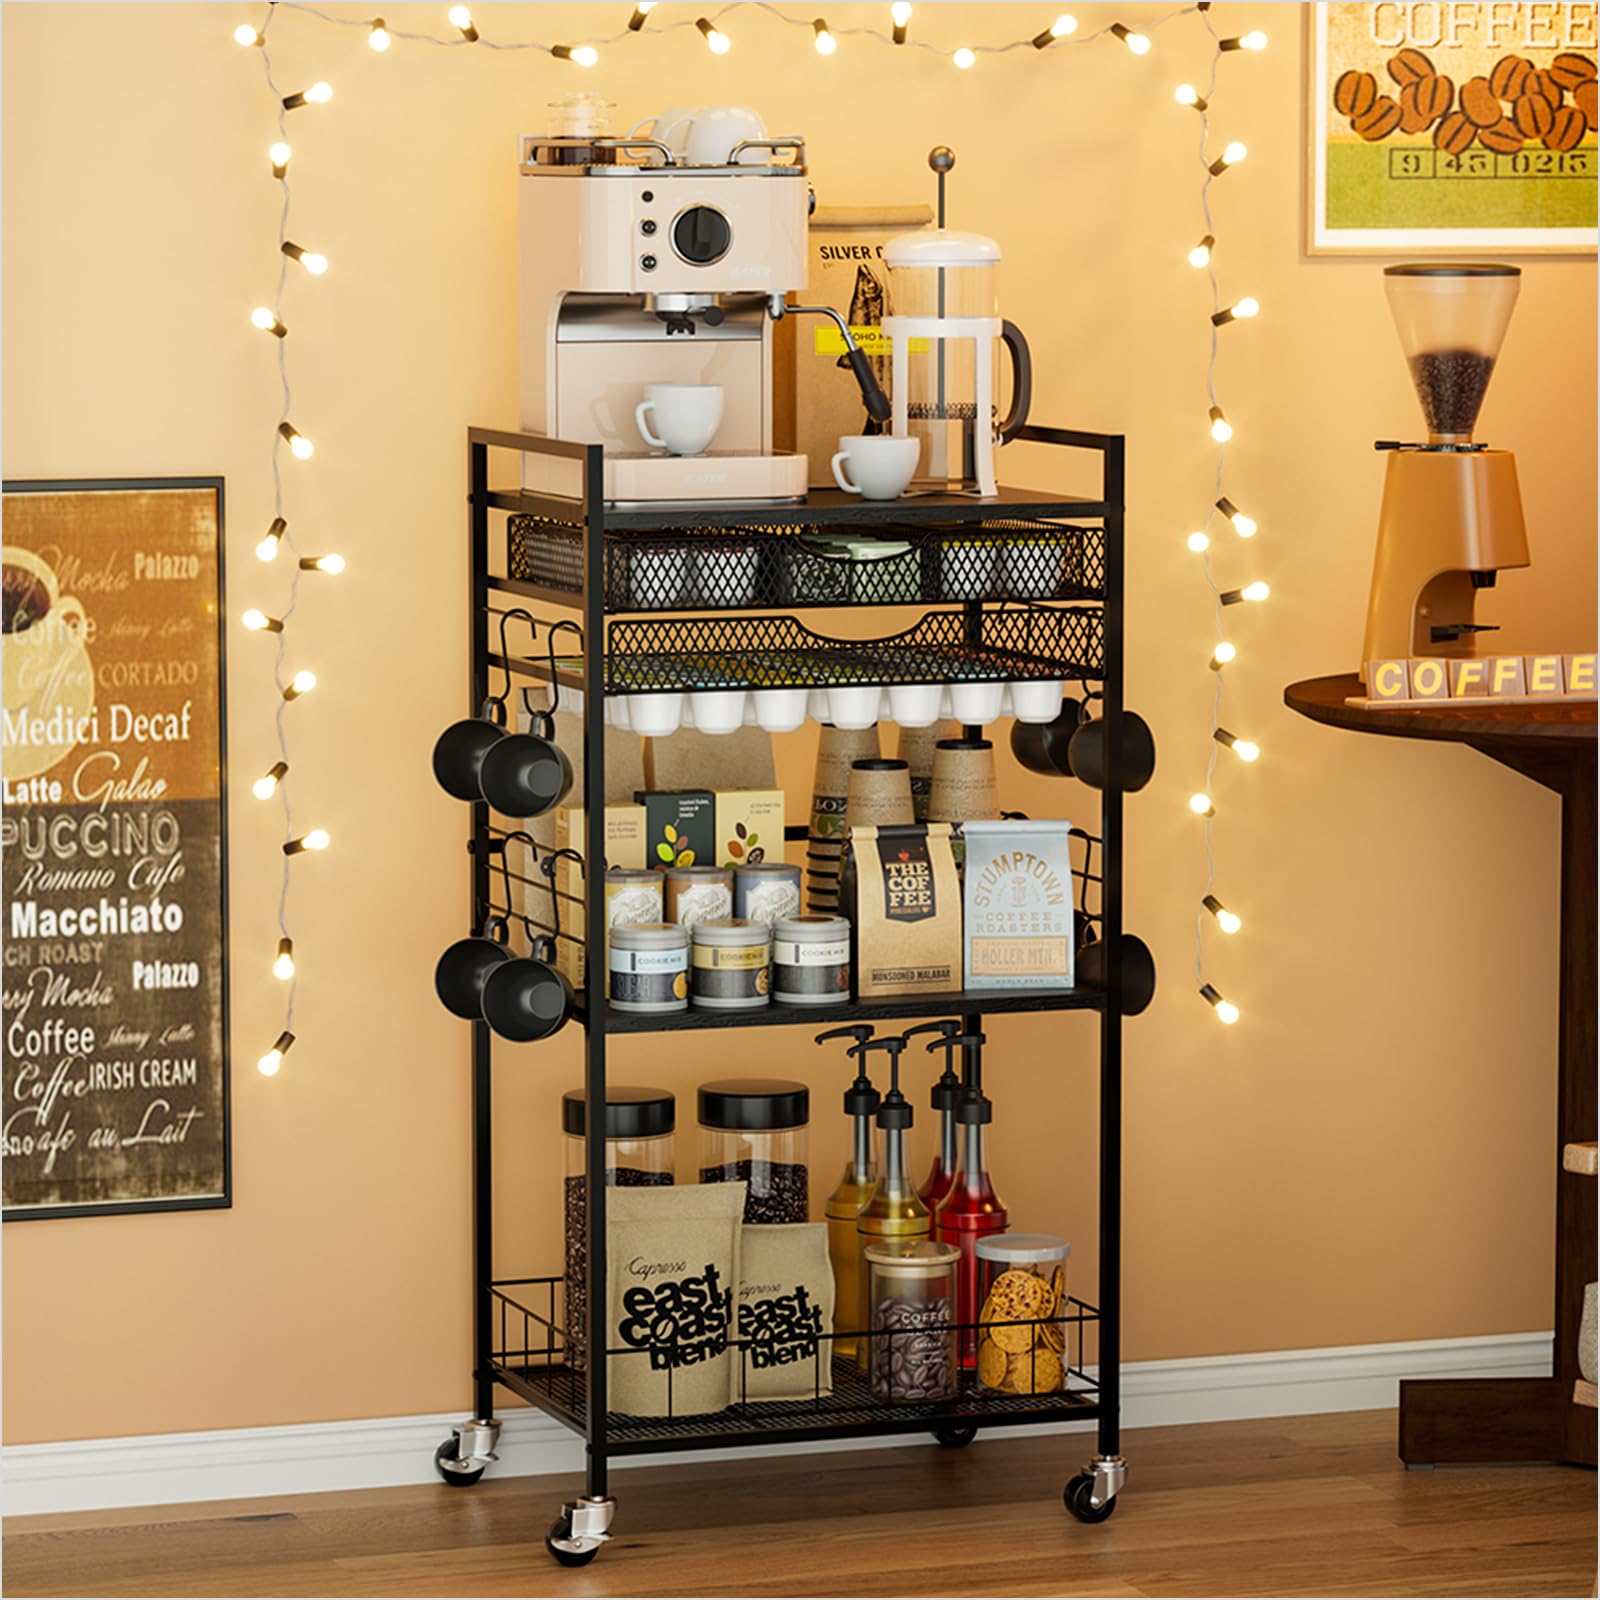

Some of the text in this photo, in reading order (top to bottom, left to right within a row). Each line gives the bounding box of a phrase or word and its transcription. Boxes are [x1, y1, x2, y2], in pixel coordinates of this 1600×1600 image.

[1370, 2, 1598, 49] COFFEE
[1403, 154, 1421, 173] 9
[820, 245, 872, 260] SILVER
[133, 552, 200, 581] Palazzo
[98, 661, 198, 688] CORTADO
[1375, 656, 1596, 697] COFFEE
[2, 700, 192, 746] Medici Decaf
[3, 777, 63, 803] Latte
[14, 861, 116, 896] Romano
[885, 862, 929, 876] THE
[888, 876, 929, 891] COF
[974, 851, 1064, 908] STUMPTOWN
[889, 891, 931, 906] FEE
[11, 897, 184, 938] Macchiato
[39, 941, 103, 965] ROAST
[28, 966, 114, 1008] Mocha
[132, 960, 200, 990] Palazzo
[872, 968, 950, 982] MONSOONED MALABAR
[8, 1018, 96, 1057] Coffee
[14, 1051, 197, 1126] Coffee IRISH CREAM
[88, 1128, 121, 1148] au
[121, 1099, 204, 1147] Lait
[624, 1256, 687, 1281] Capresso
[623, 1264, 720, 1319] east
[739, 1281, 781, 1299] apresso
[618, 1287, 732, 1348] coast
[738, 1285, 811, 1328] east
[901, 1310, 951, 1324] COFFEE
[649, 1323, 729, 1370] blend
[750, 1337, 818, 1369] blend
